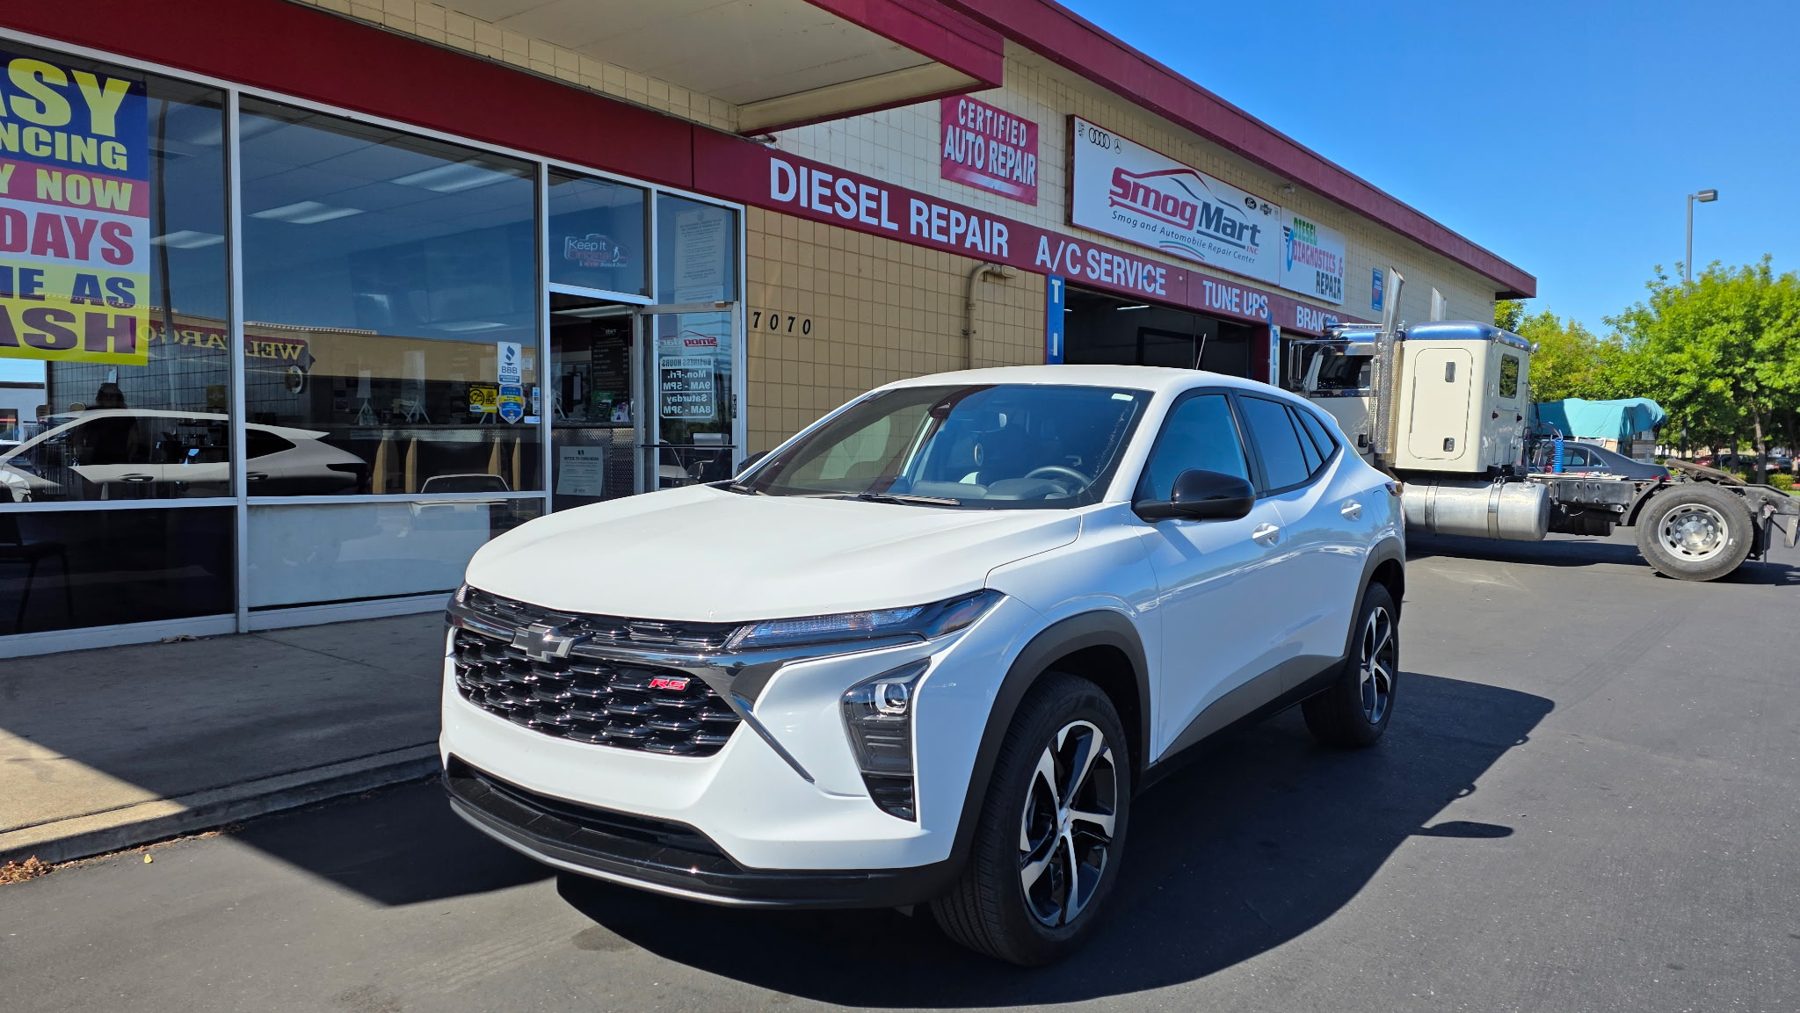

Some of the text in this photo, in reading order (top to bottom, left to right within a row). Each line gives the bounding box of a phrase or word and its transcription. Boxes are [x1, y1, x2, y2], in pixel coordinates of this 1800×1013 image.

[0, 58, 131, 138] SY
[958, 98, 1027, 147] CERTIFIED
[943, 124, 1036, 187] AUTO REPAIR
[36, 168, 133, 211] NOW
[770, 157, 1009, 258] DIESEL REPAIR
[1109, 167, 1261, 247] Smog Mart
[569, 239, 598, 252] Keep
[1112, 210, 1255, 264] Smog and Automobile Repair Center
[1293, 217, 1317, 246] DIESEL
[1035, 235, 1166, 296] A/C SERVICE
[1293, 239, 1336, 274] DIAGNOSTICS
[70, 273, 136, 309] AS
[1202, 280, 1269, 319] TUNE UPS
[1315, 270, 1341, 300] REPAIR
[753, 311, 811, 335] 7070
[501, 366, 518, 374] BBB
[649, 677, 688, 691] RS
